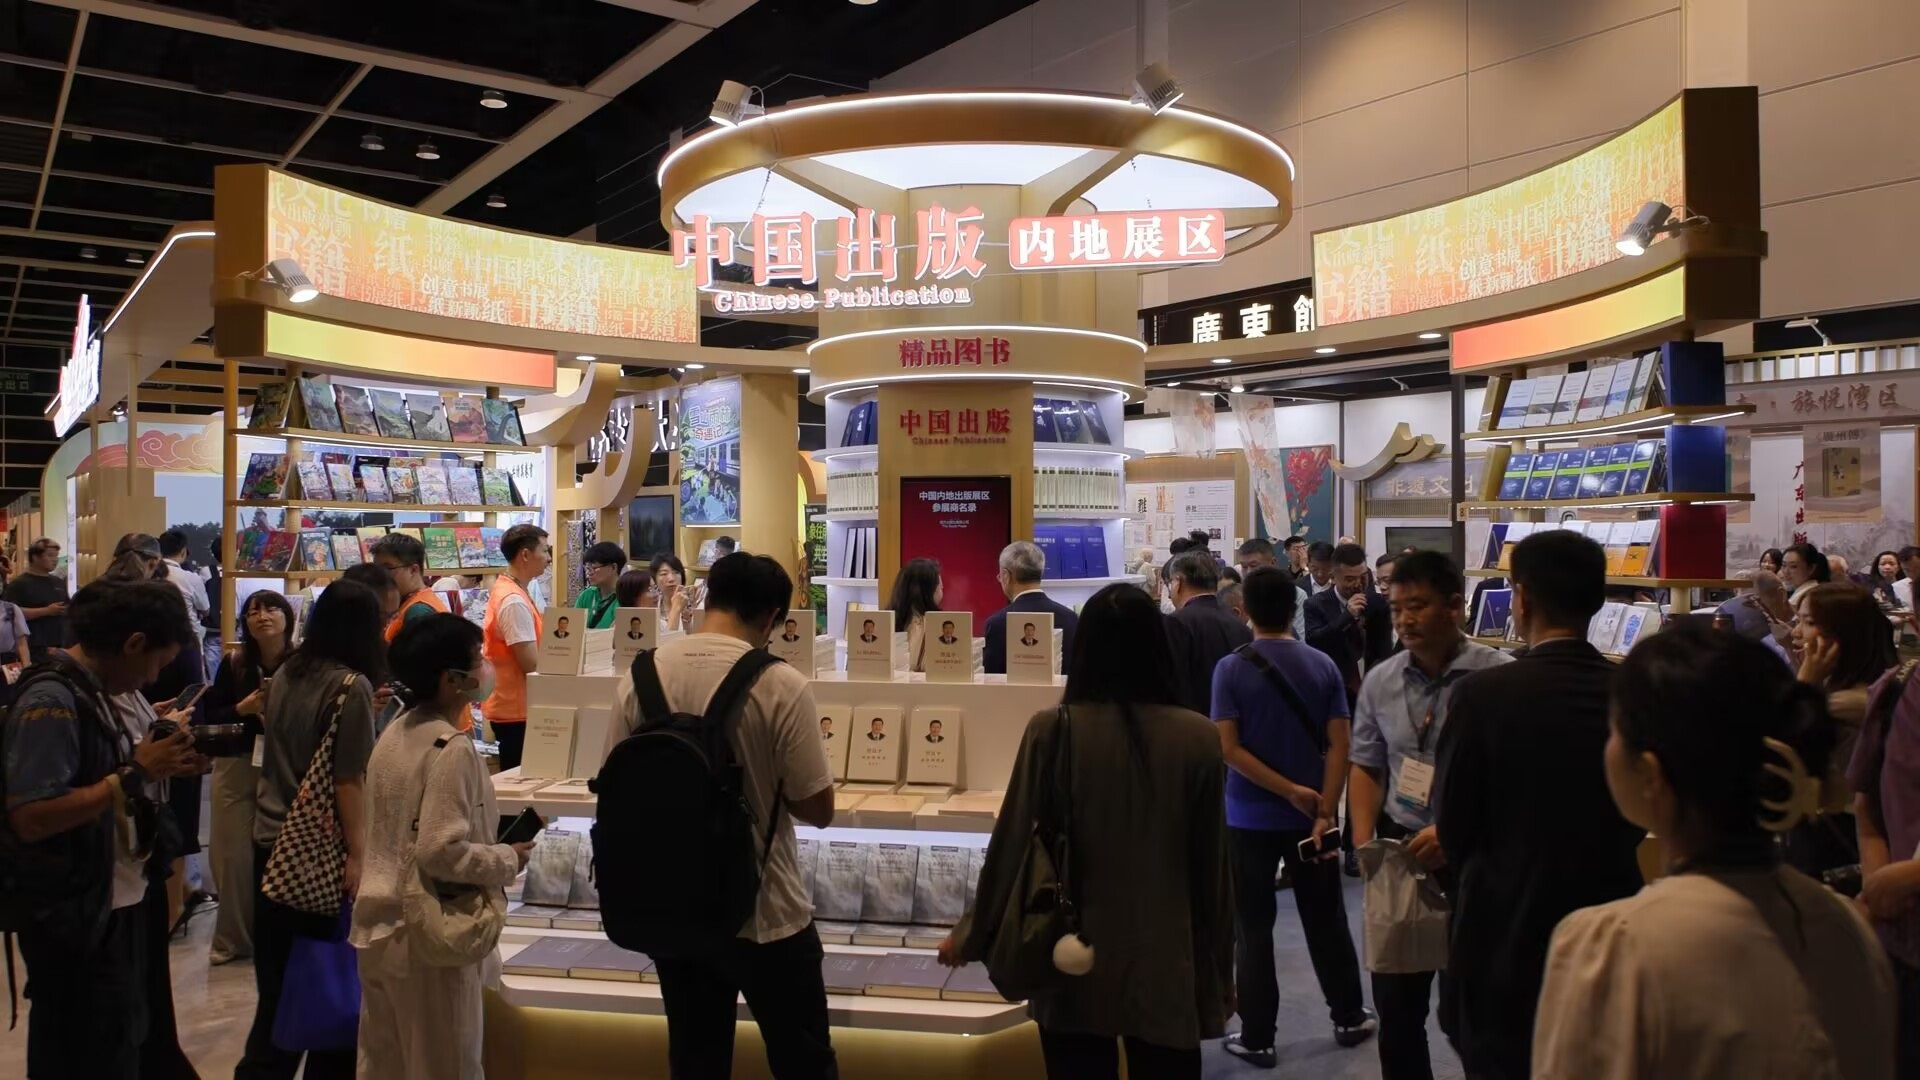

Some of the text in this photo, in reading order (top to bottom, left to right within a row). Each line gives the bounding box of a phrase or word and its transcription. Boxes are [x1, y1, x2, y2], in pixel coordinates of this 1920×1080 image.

[672, 203, 986, 289] 中国出版
[1018, 213, 1219, 263] 内地展区
[714, 284, 971, 313] Chinese Publication
[899, 337, 1011, 367] 精品图书
[900, 408, 1010, 436] 中国出版
[911, 436, 1006, 446] Chinese Publication
[919, 490, 990, 501] 中国内地出版展区
[932, 502, 977, 513] 参展商名录
